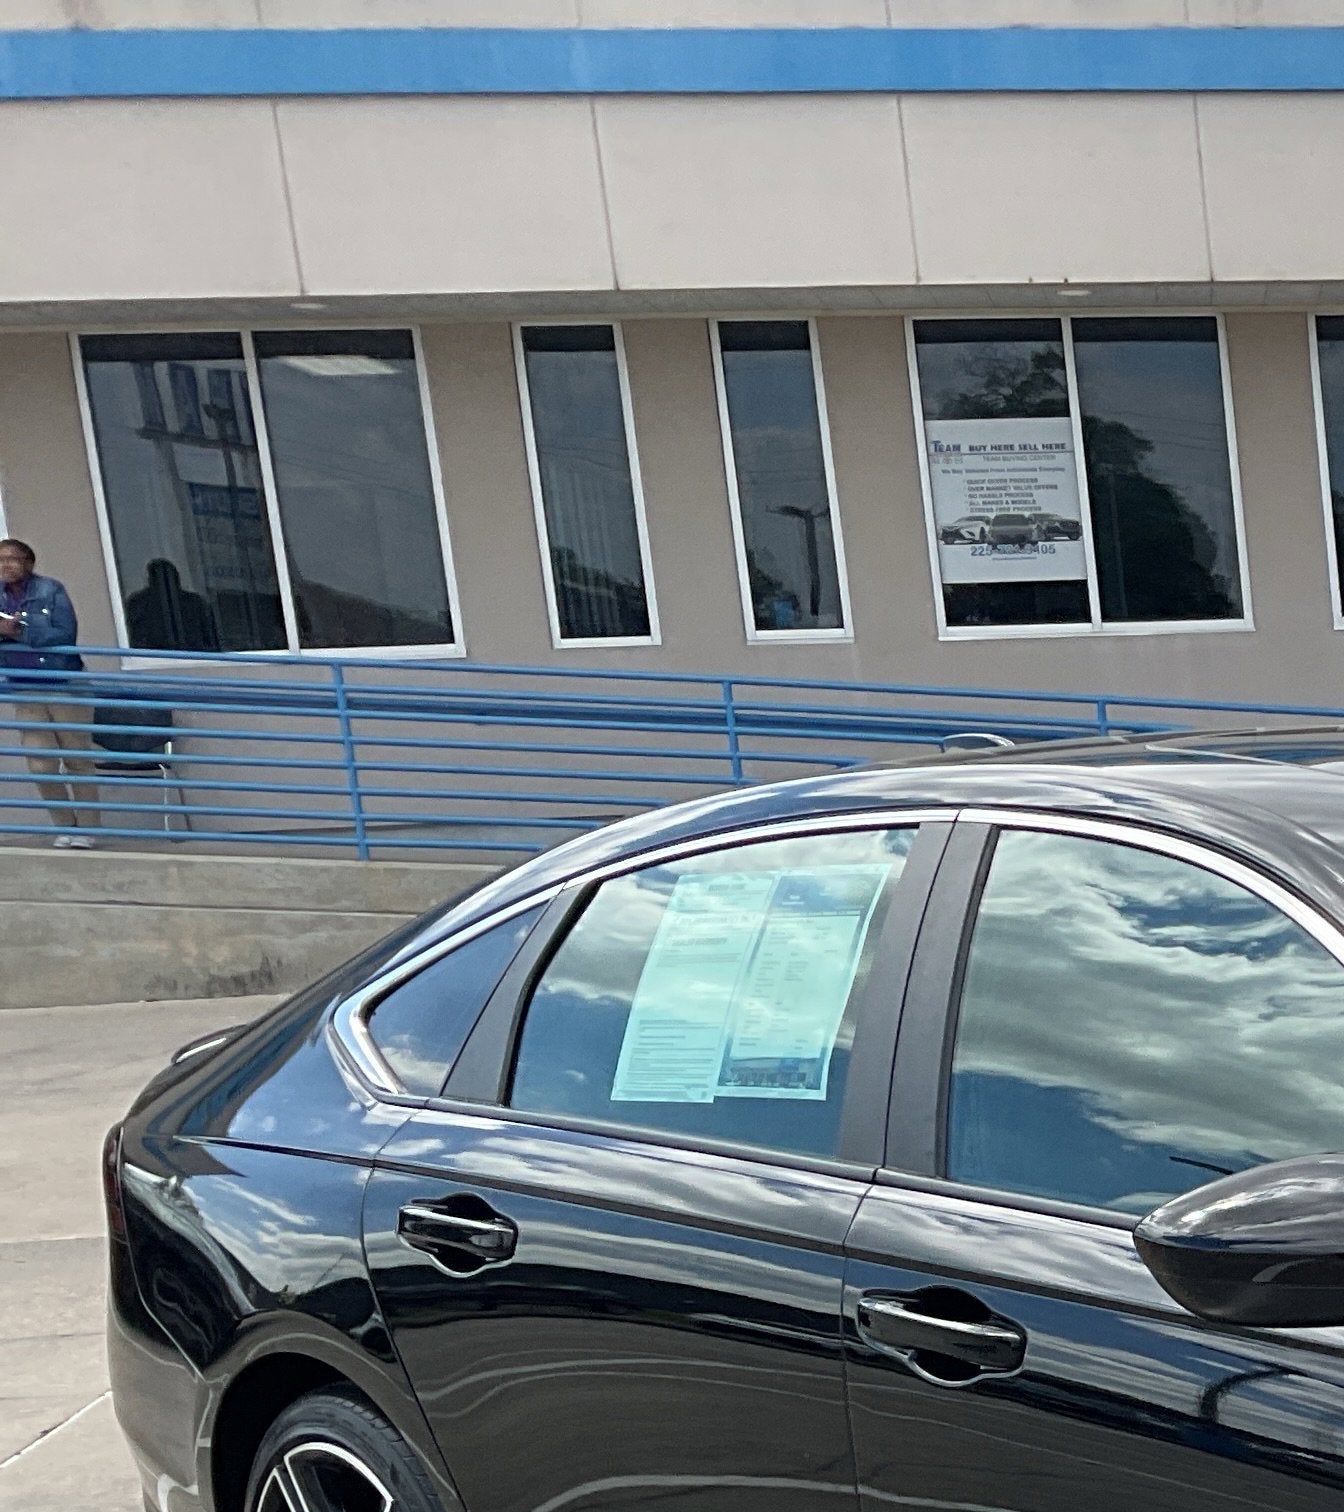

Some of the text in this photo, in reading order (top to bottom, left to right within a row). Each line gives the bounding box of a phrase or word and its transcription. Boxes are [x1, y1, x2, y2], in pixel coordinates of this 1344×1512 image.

[969, 442, 1066, 452] BUY HERE SELL HERE
